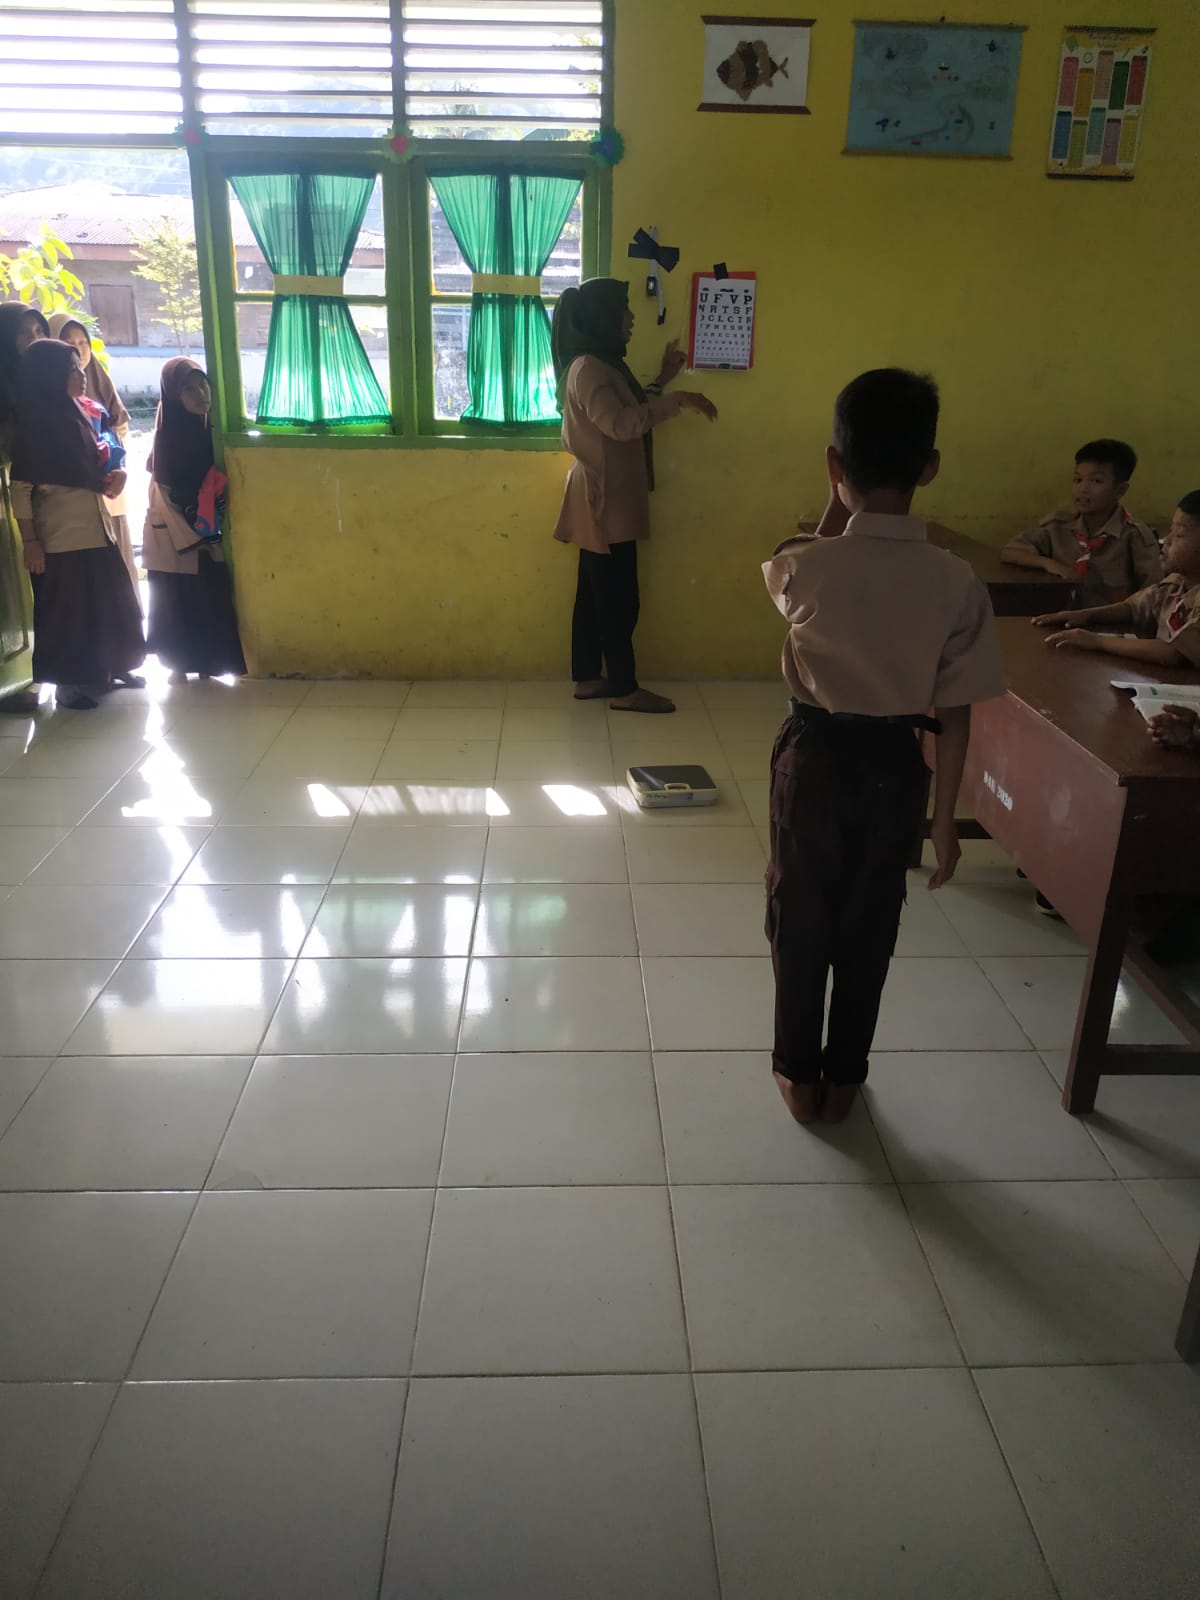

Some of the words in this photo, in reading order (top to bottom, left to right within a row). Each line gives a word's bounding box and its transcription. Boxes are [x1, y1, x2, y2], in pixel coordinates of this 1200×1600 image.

[700, 293, 708, 303] U
[714, 293, 723, 304] F
[730, 294, 739, 304] V
[744, 295, 753, 305] P
